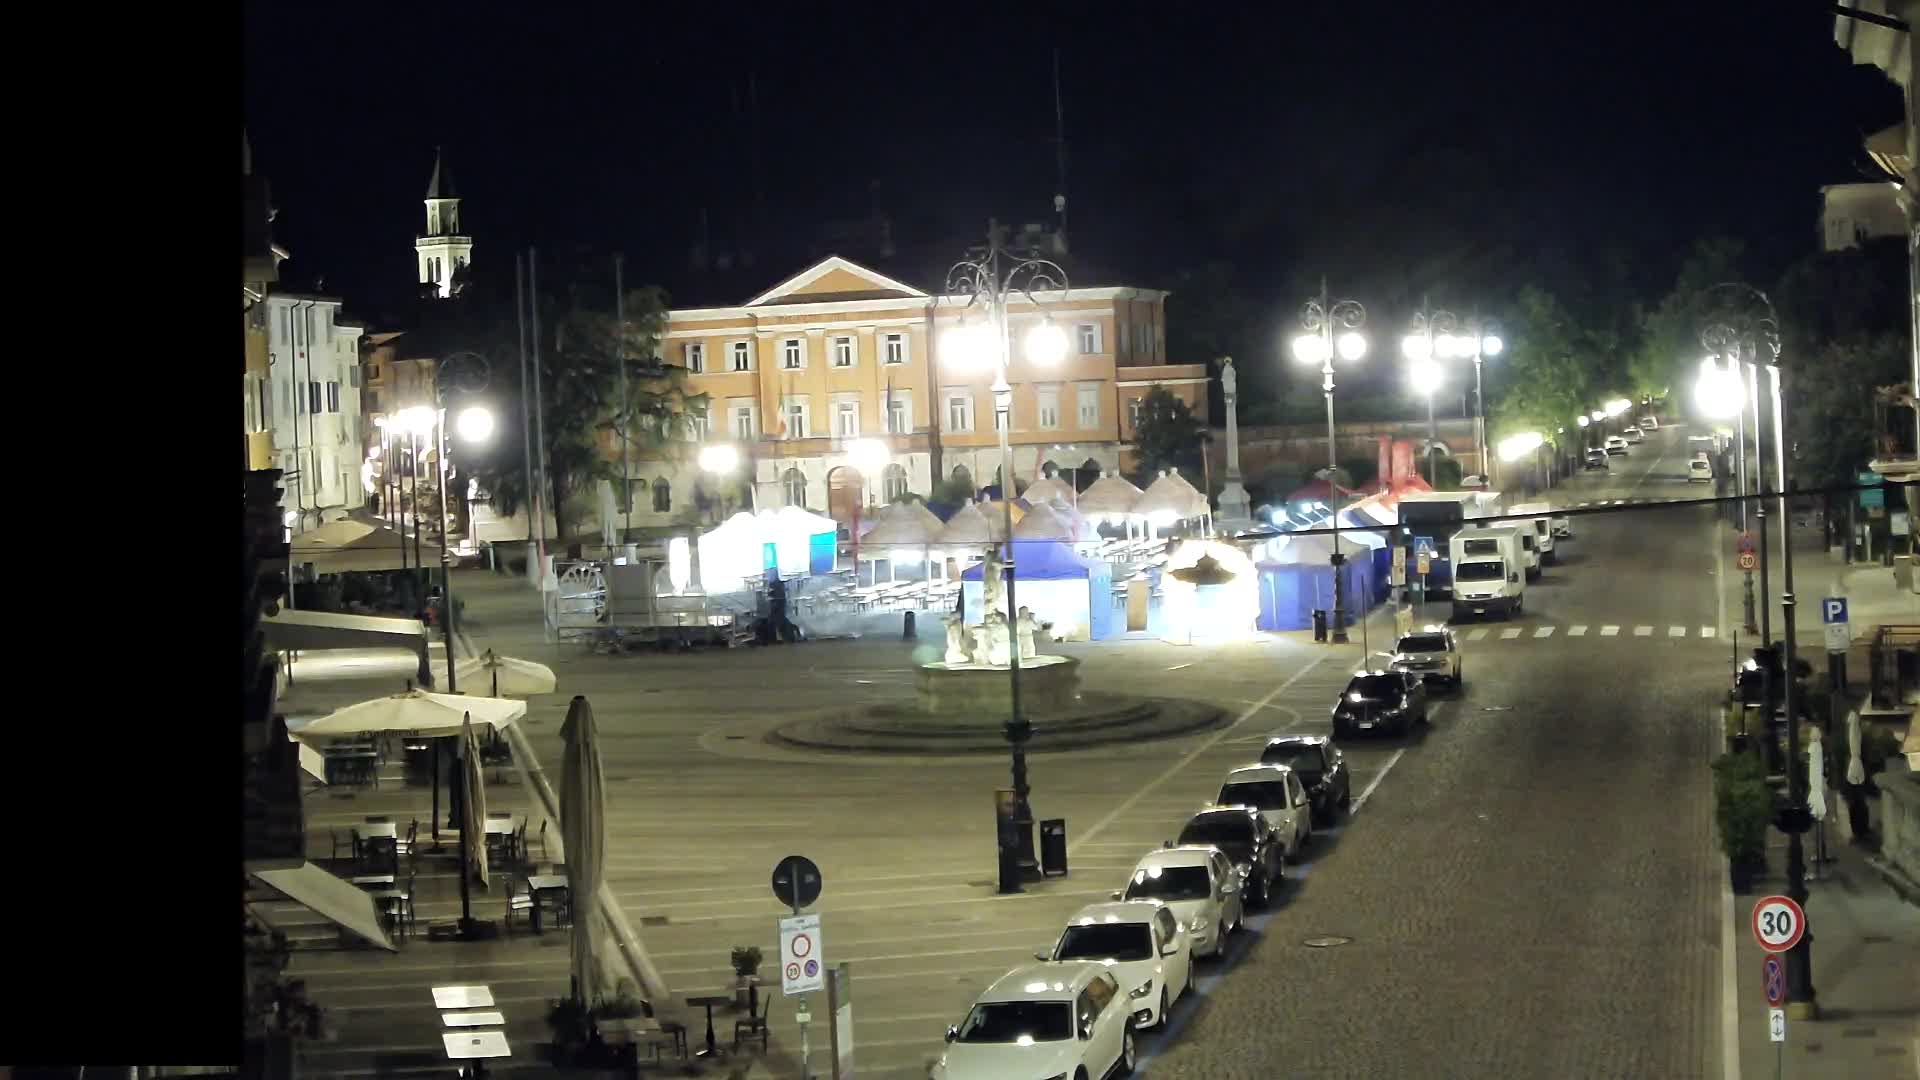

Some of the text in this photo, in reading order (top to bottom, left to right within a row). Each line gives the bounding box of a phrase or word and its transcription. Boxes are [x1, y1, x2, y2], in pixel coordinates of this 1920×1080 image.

[1743, 557, 1752, 565] 20
[1827, 601, 1842, 621] P
[1763, 911, 1792, 936] 30
